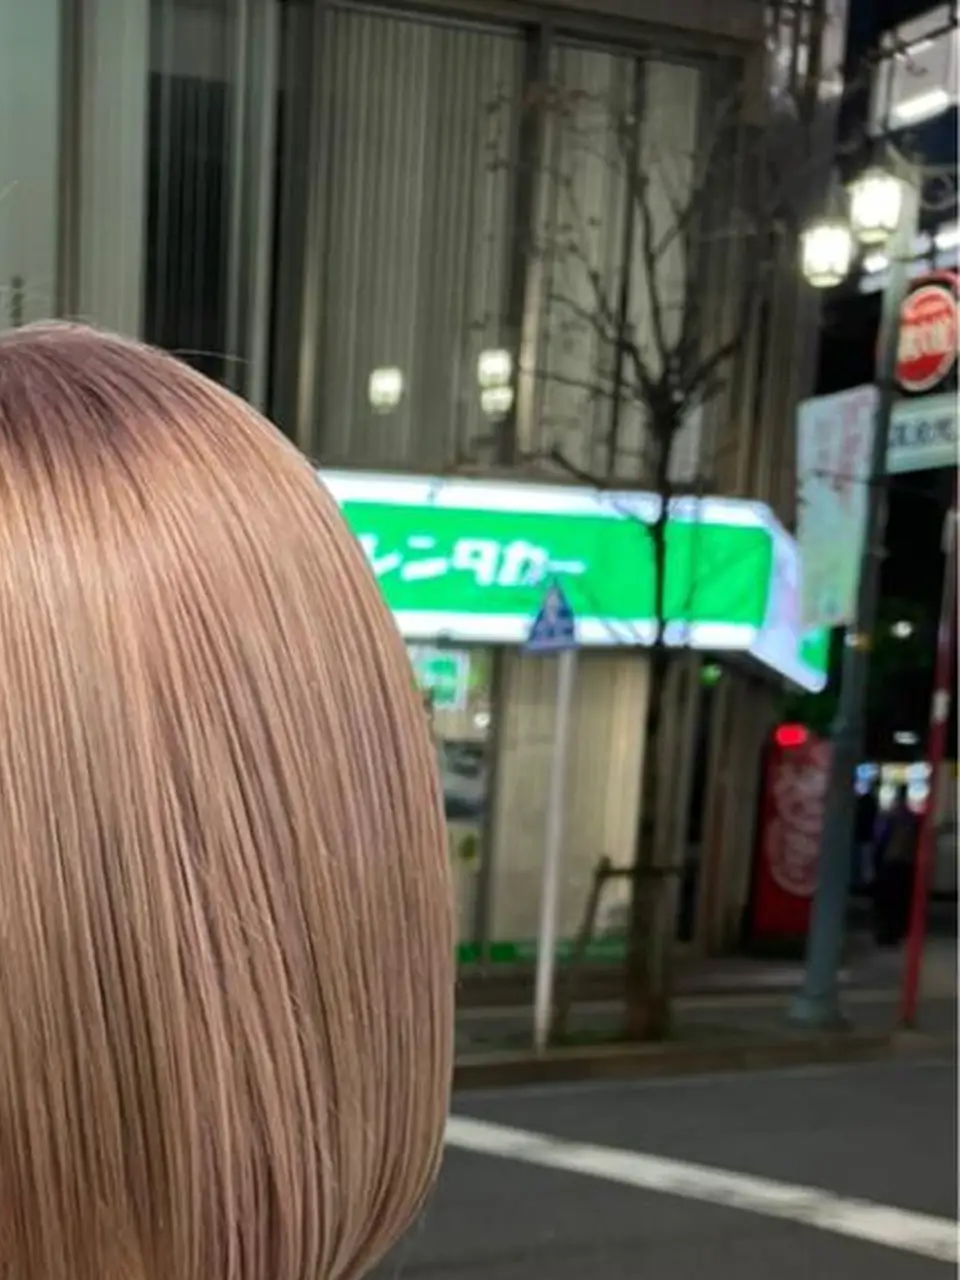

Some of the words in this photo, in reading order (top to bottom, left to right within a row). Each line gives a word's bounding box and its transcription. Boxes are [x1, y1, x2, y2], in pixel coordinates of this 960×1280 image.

[357, 533, 588, 587] レンタカー
